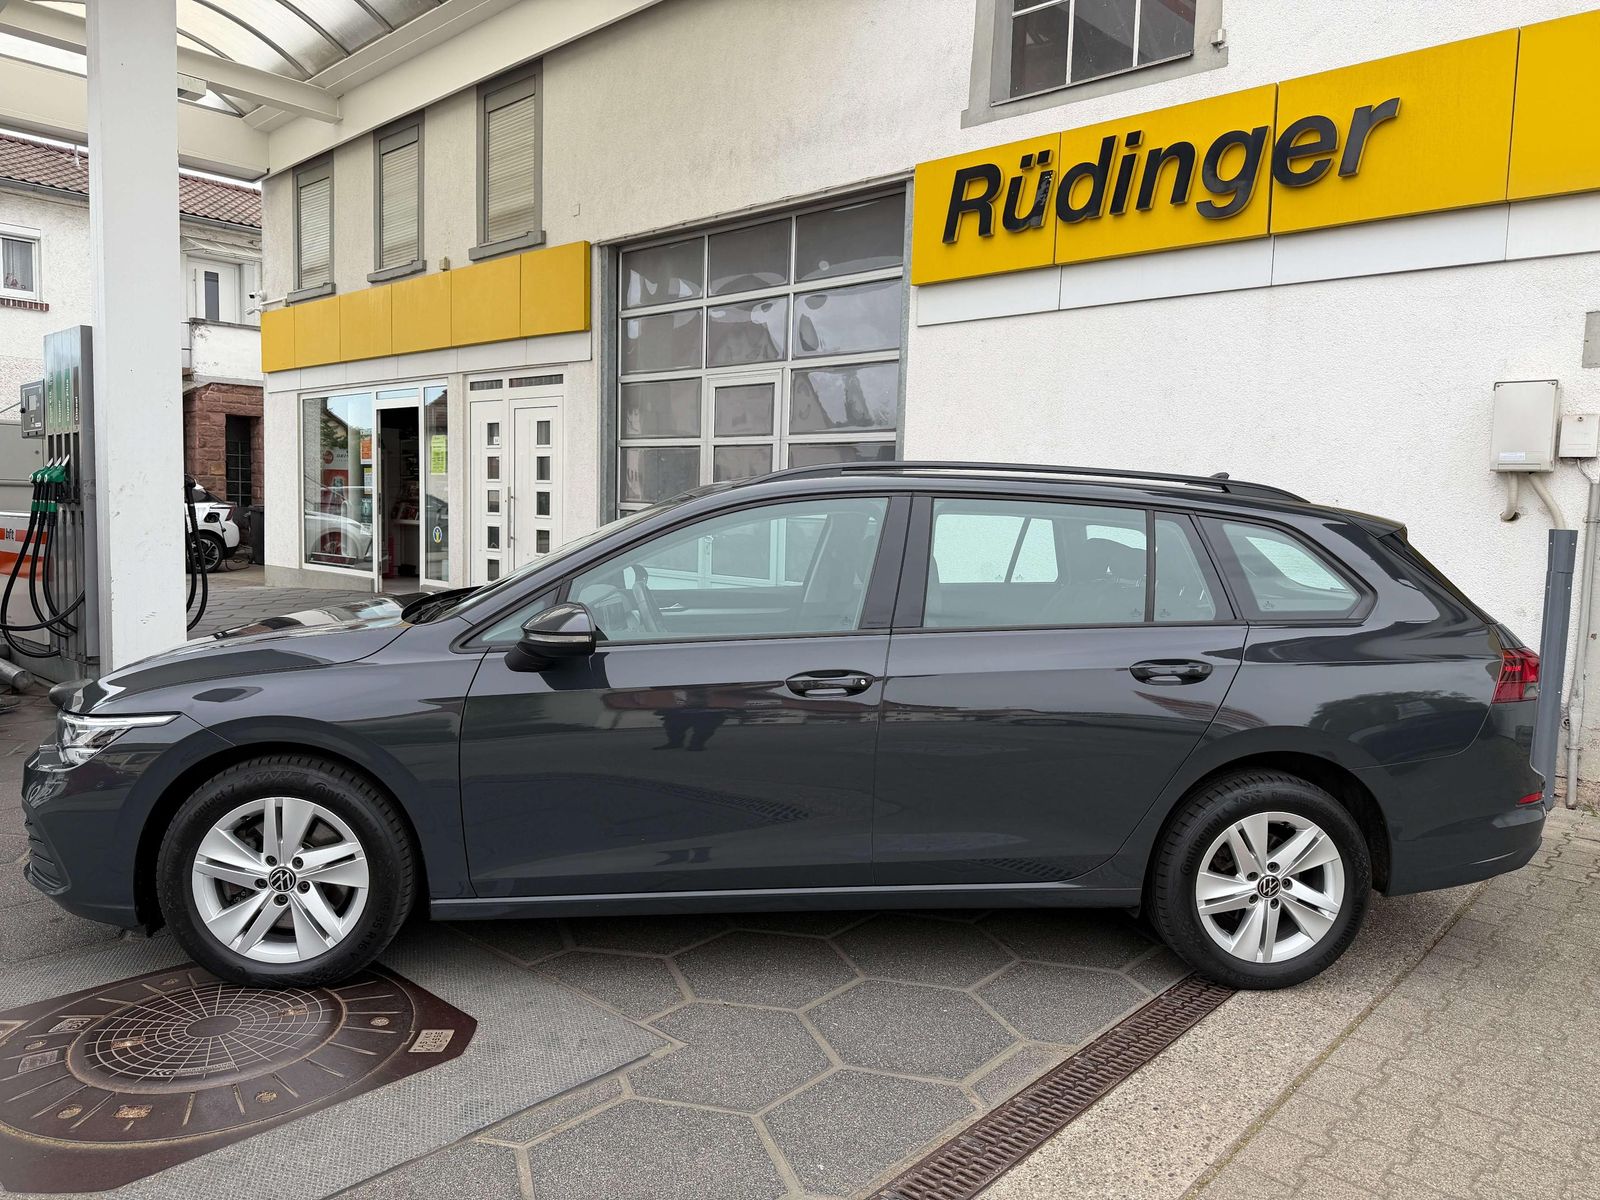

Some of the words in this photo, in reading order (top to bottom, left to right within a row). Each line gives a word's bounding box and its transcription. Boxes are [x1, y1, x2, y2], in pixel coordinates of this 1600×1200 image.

[942, 97, 1400, 244] Rüdinger
[6, 528, 14, 540] bft
[1181, 813, 1222, 876] Continental
